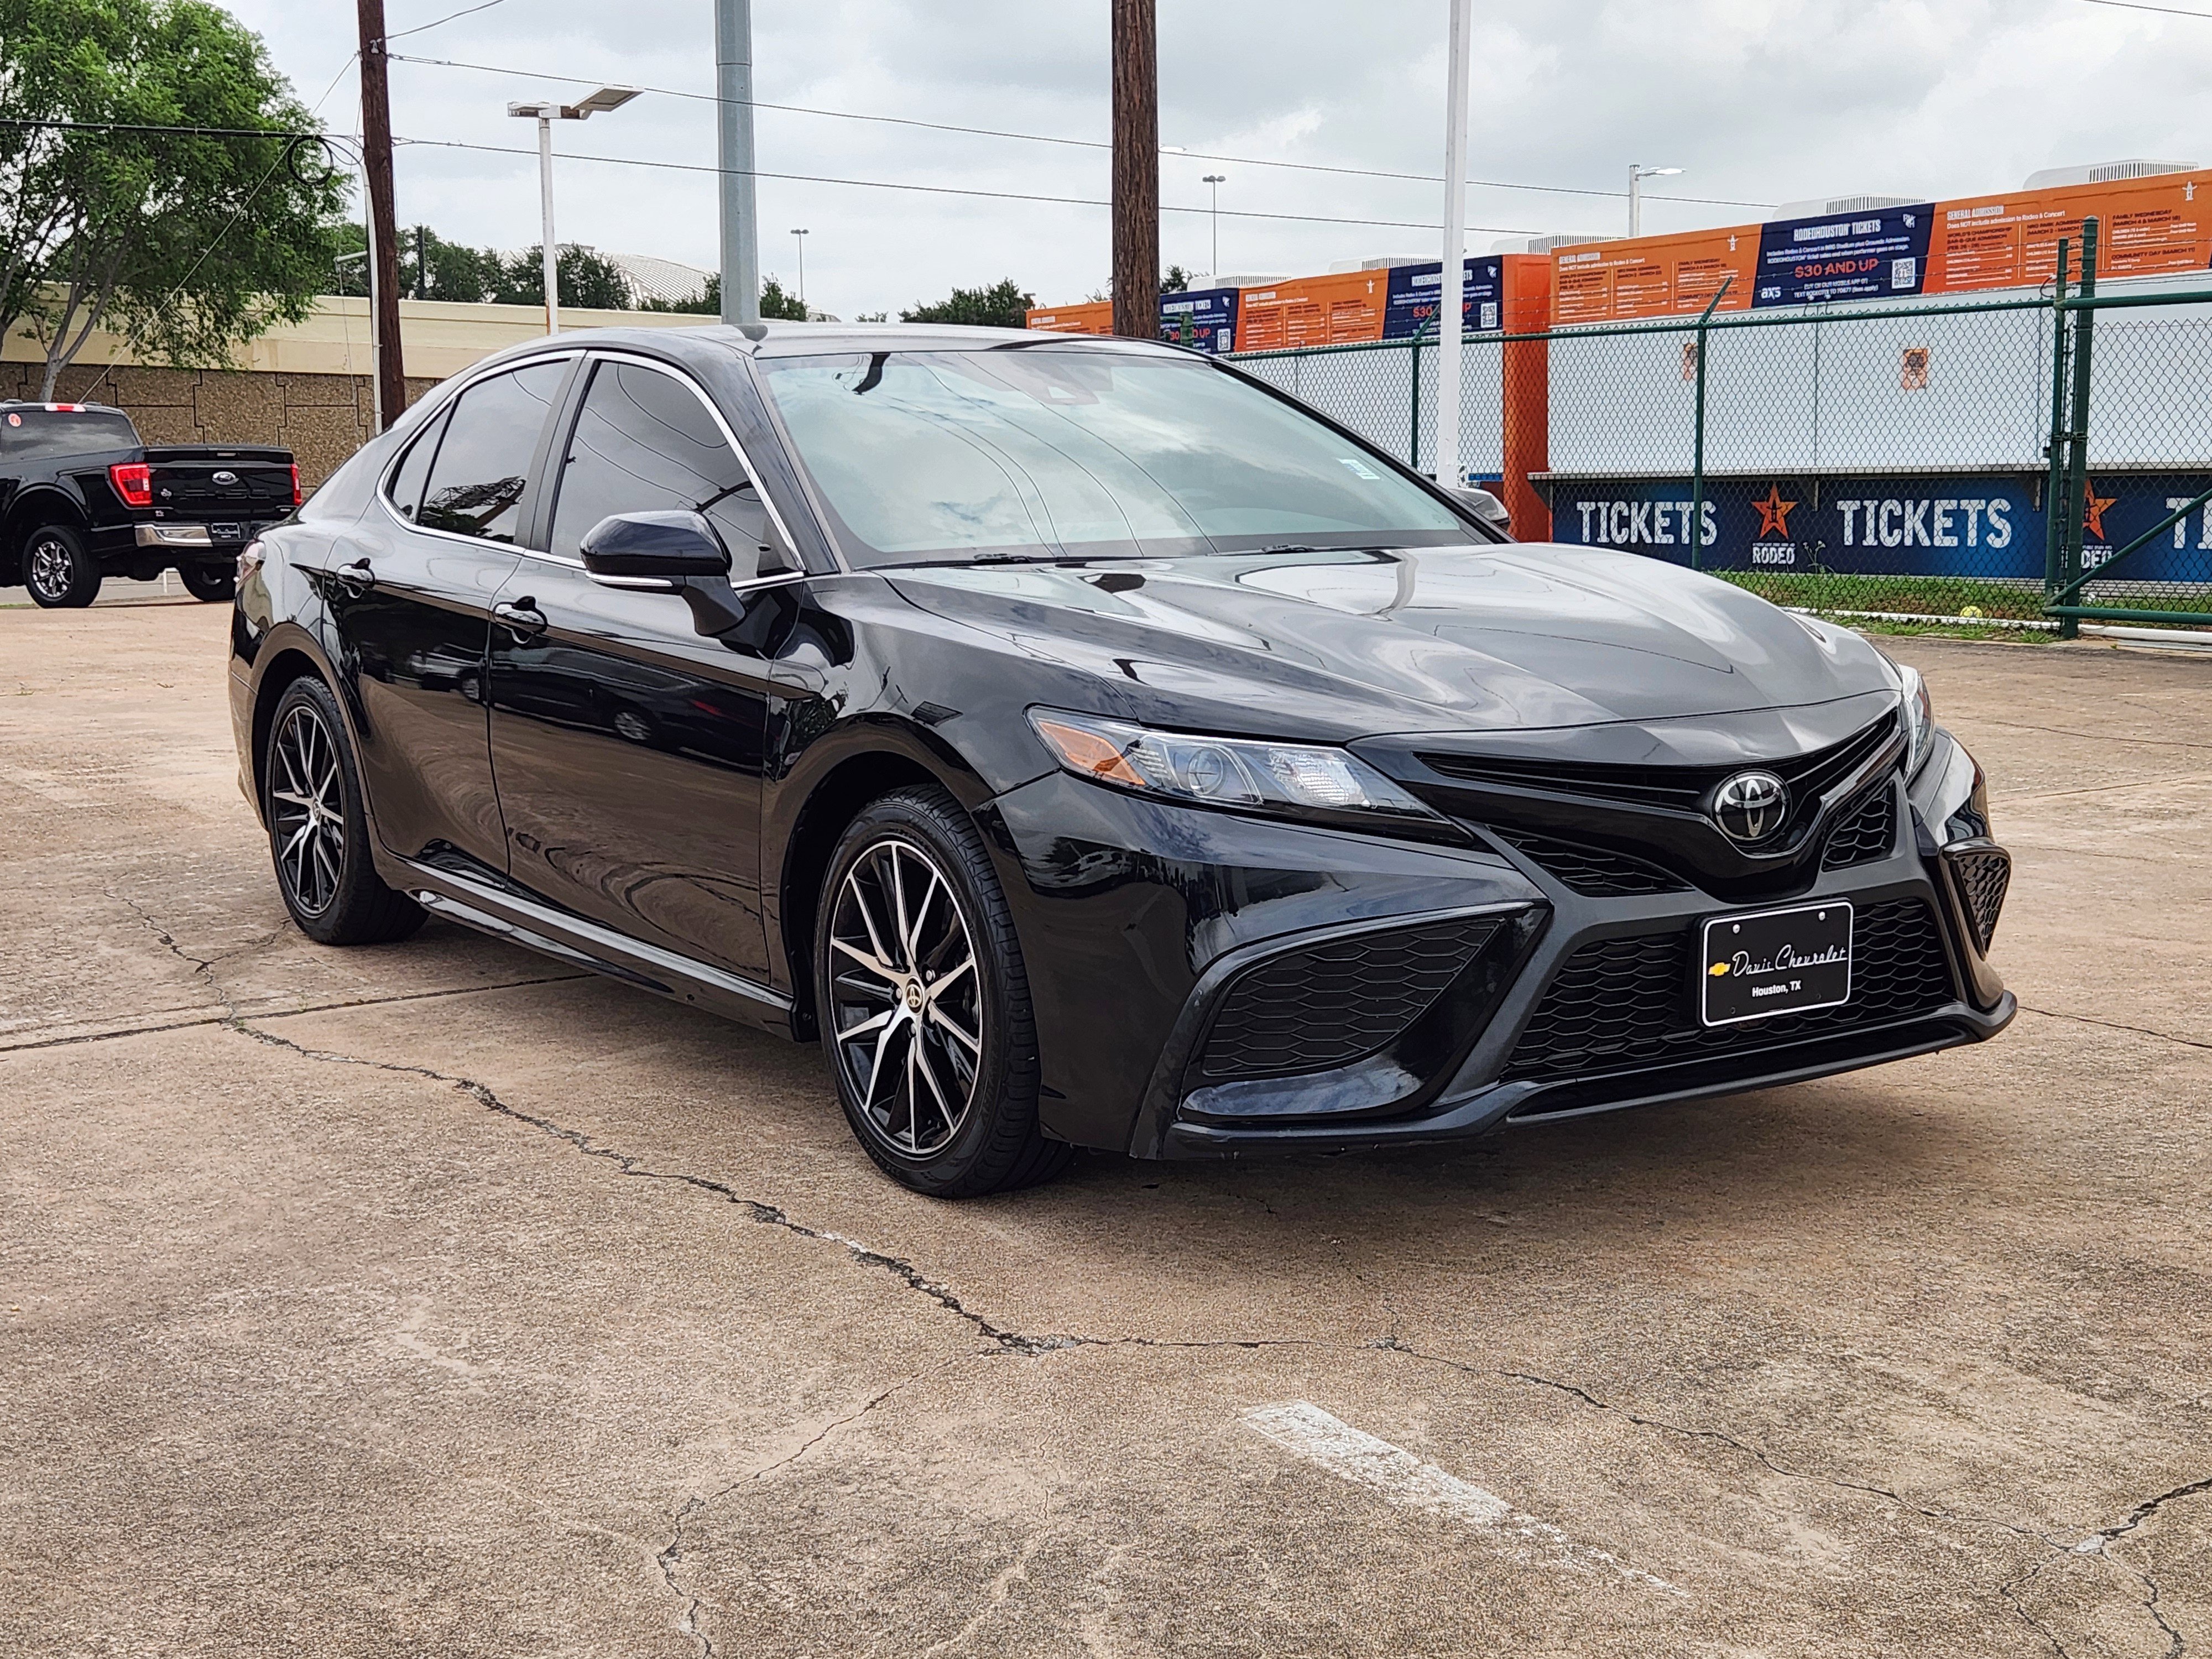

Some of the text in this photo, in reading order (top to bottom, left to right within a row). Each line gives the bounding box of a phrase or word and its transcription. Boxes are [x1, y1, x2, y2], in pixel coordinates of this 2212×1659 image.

[1852, 219, 1881, 235] TICKETS
[1825, 260, 1856, 276] AND
[1858, 258, 1879, 272] UP
[1577, 500, 1717, 546] TICKETS
[1837, 498, 2011, 548] TICKETS
[1752, 547, 1795, 564] RODEO
[1732, 944, 1848, 977] Davis Chevrolet
[1752, 980, 1801, 997] Houston, TX
